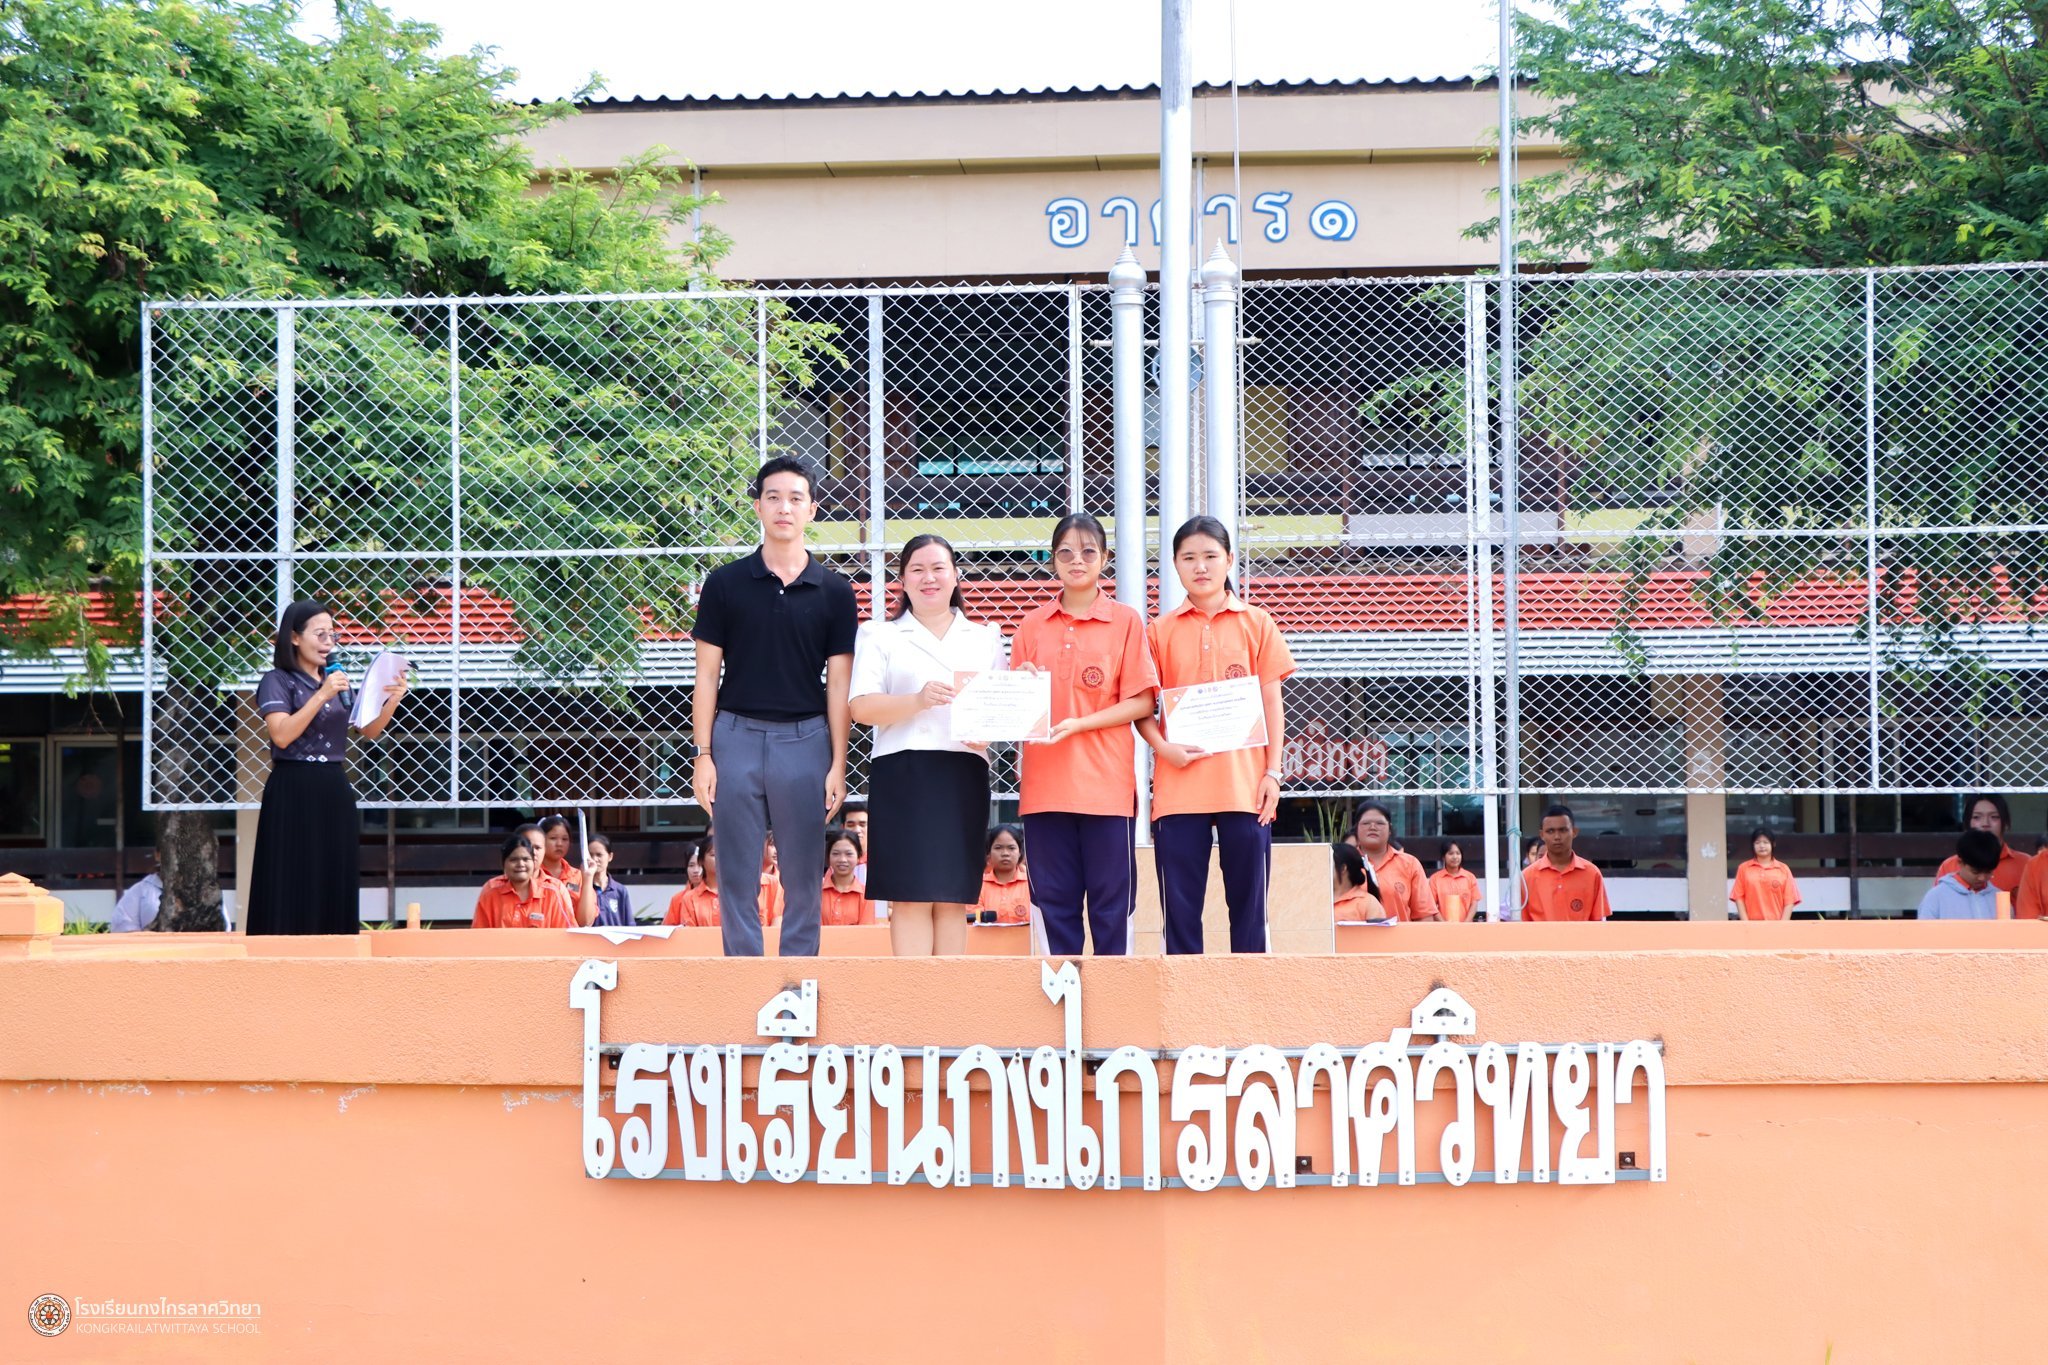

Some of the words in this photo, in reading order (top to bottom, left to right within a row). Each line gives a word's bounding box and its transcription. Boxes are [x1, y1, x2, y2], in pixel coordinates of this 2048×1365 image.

[569, 960, 1667, 1191] โรงเรียนกงไกรลาศวิทยา
